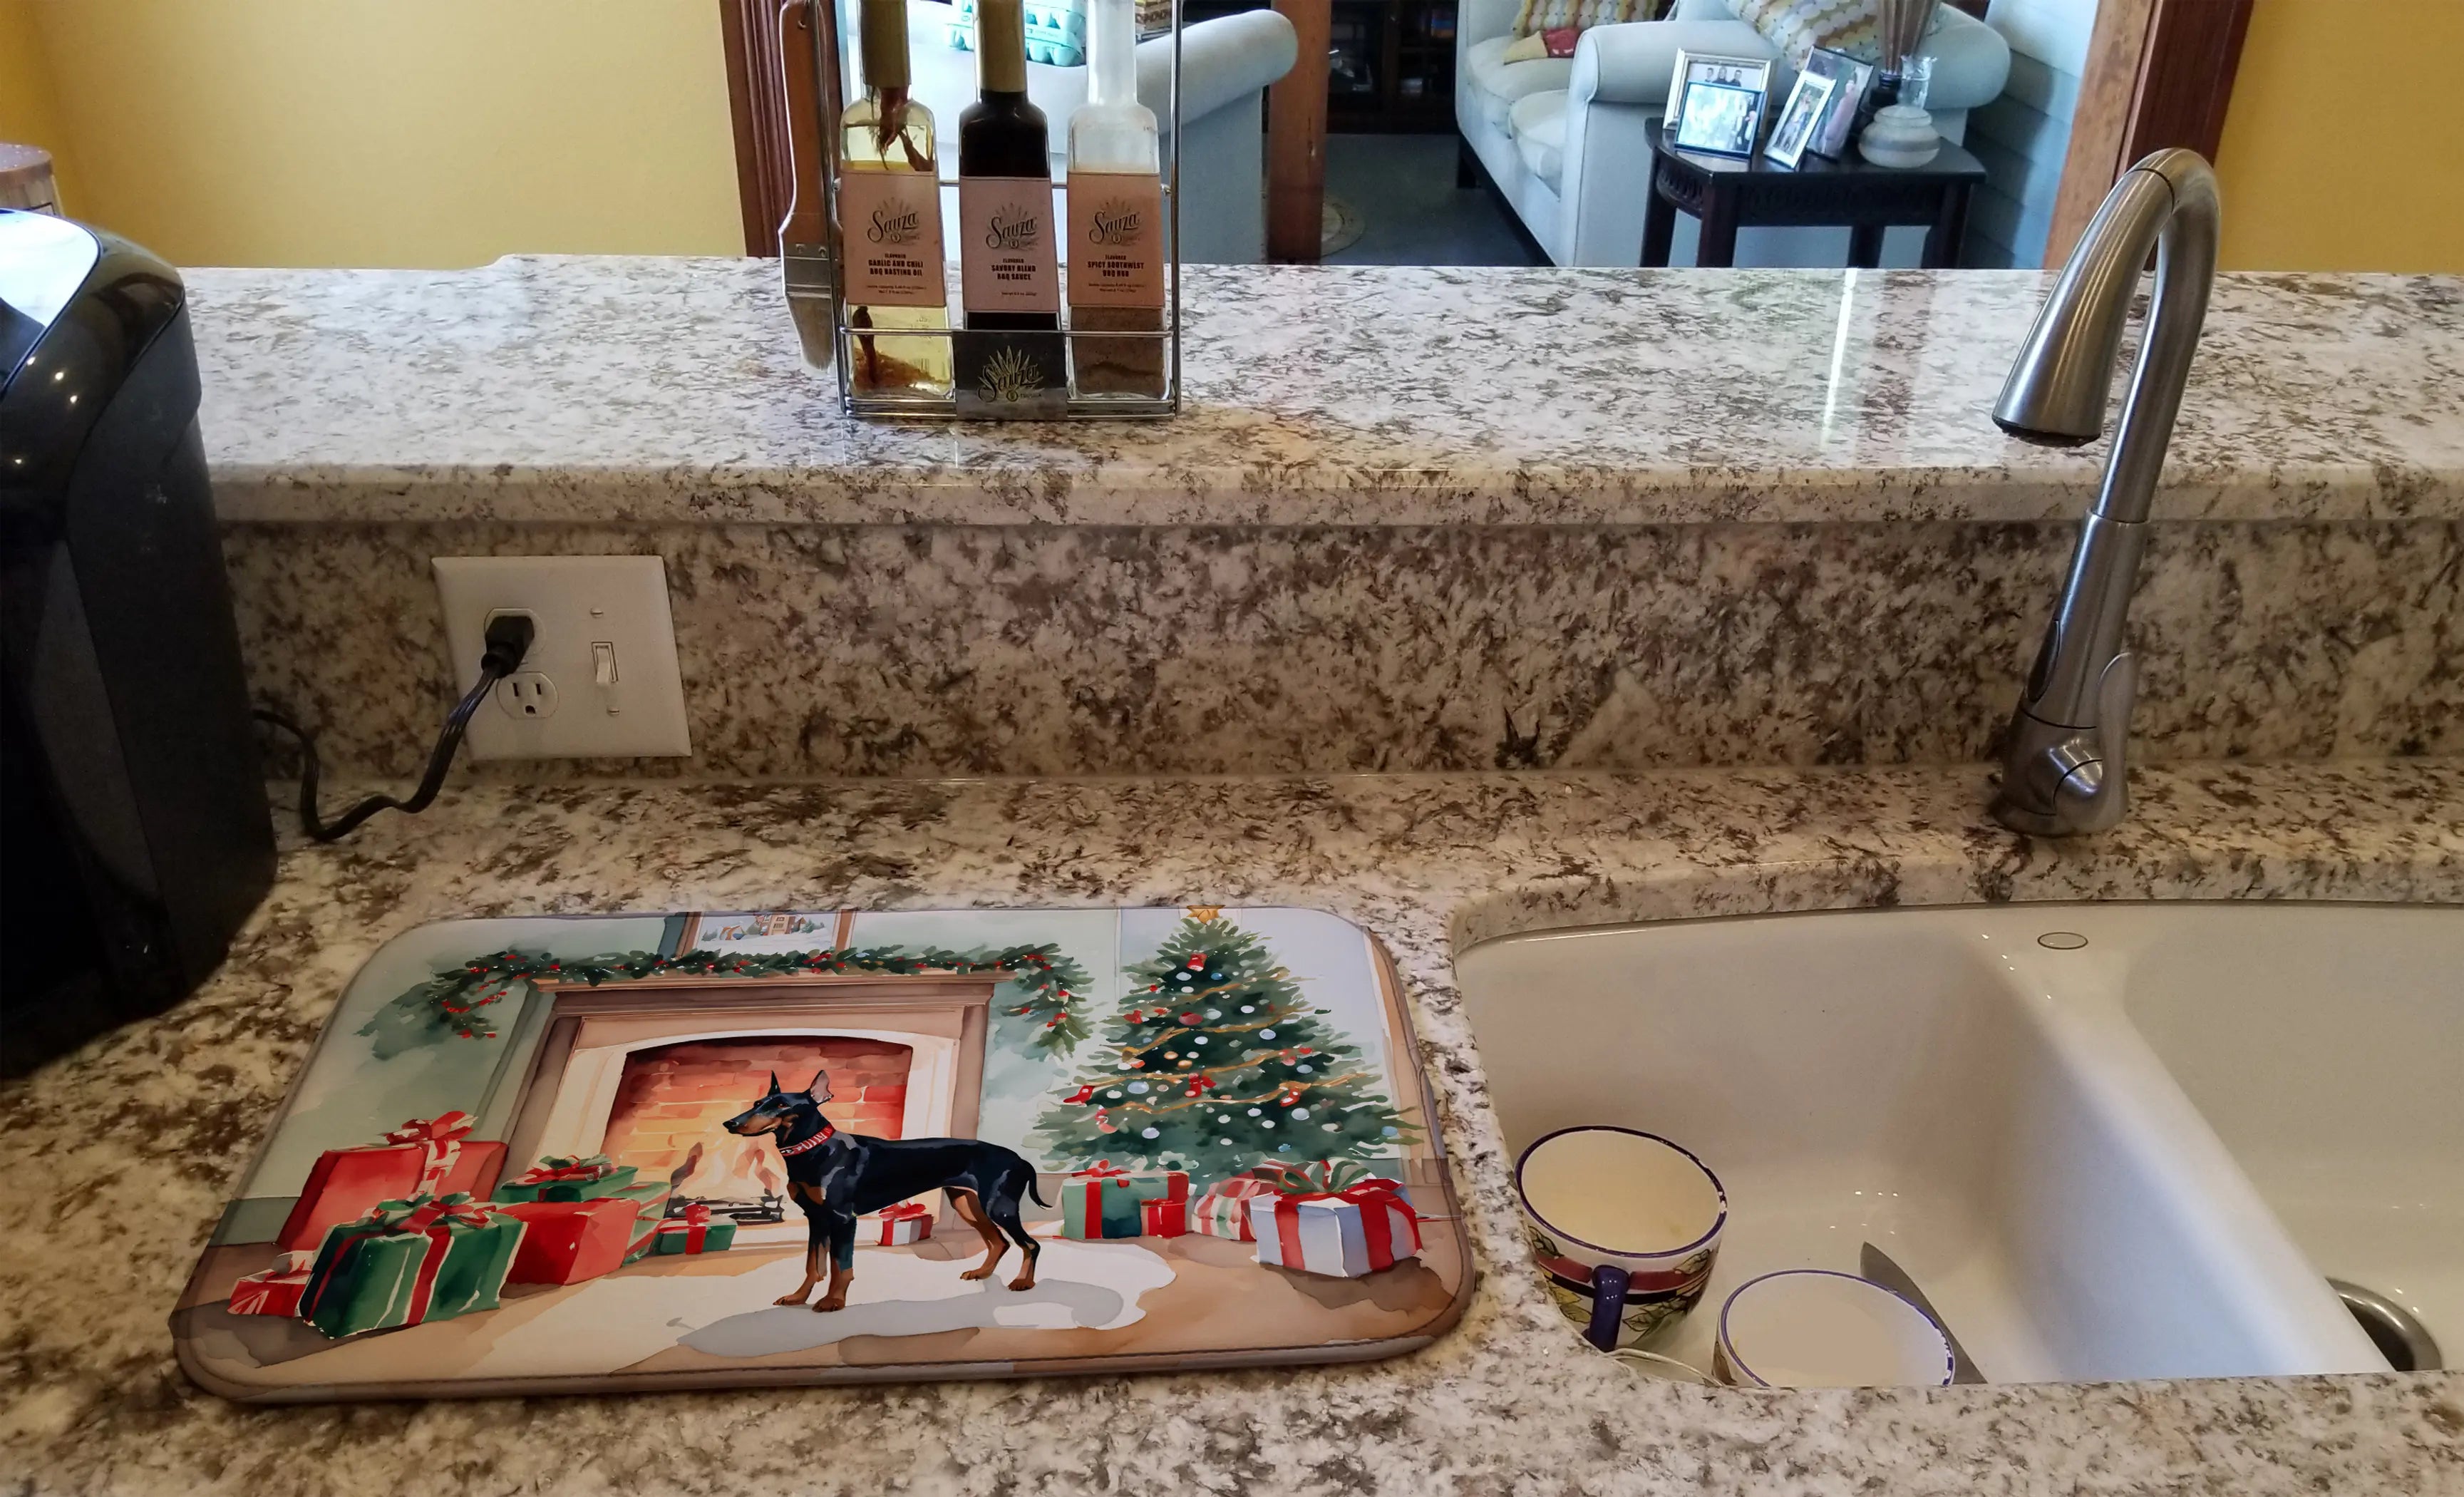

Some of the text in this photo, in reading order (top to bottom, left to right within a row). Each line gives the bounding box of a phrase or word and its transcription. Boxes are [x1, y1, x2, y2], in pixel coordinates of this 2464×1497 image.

[867, 210, 919, 243] Sauza
[986, 216, 1036, 249] Sauza
[1089, 211, 1140, 244] Sauza
[976, 364, 1043, 403] Sauza
